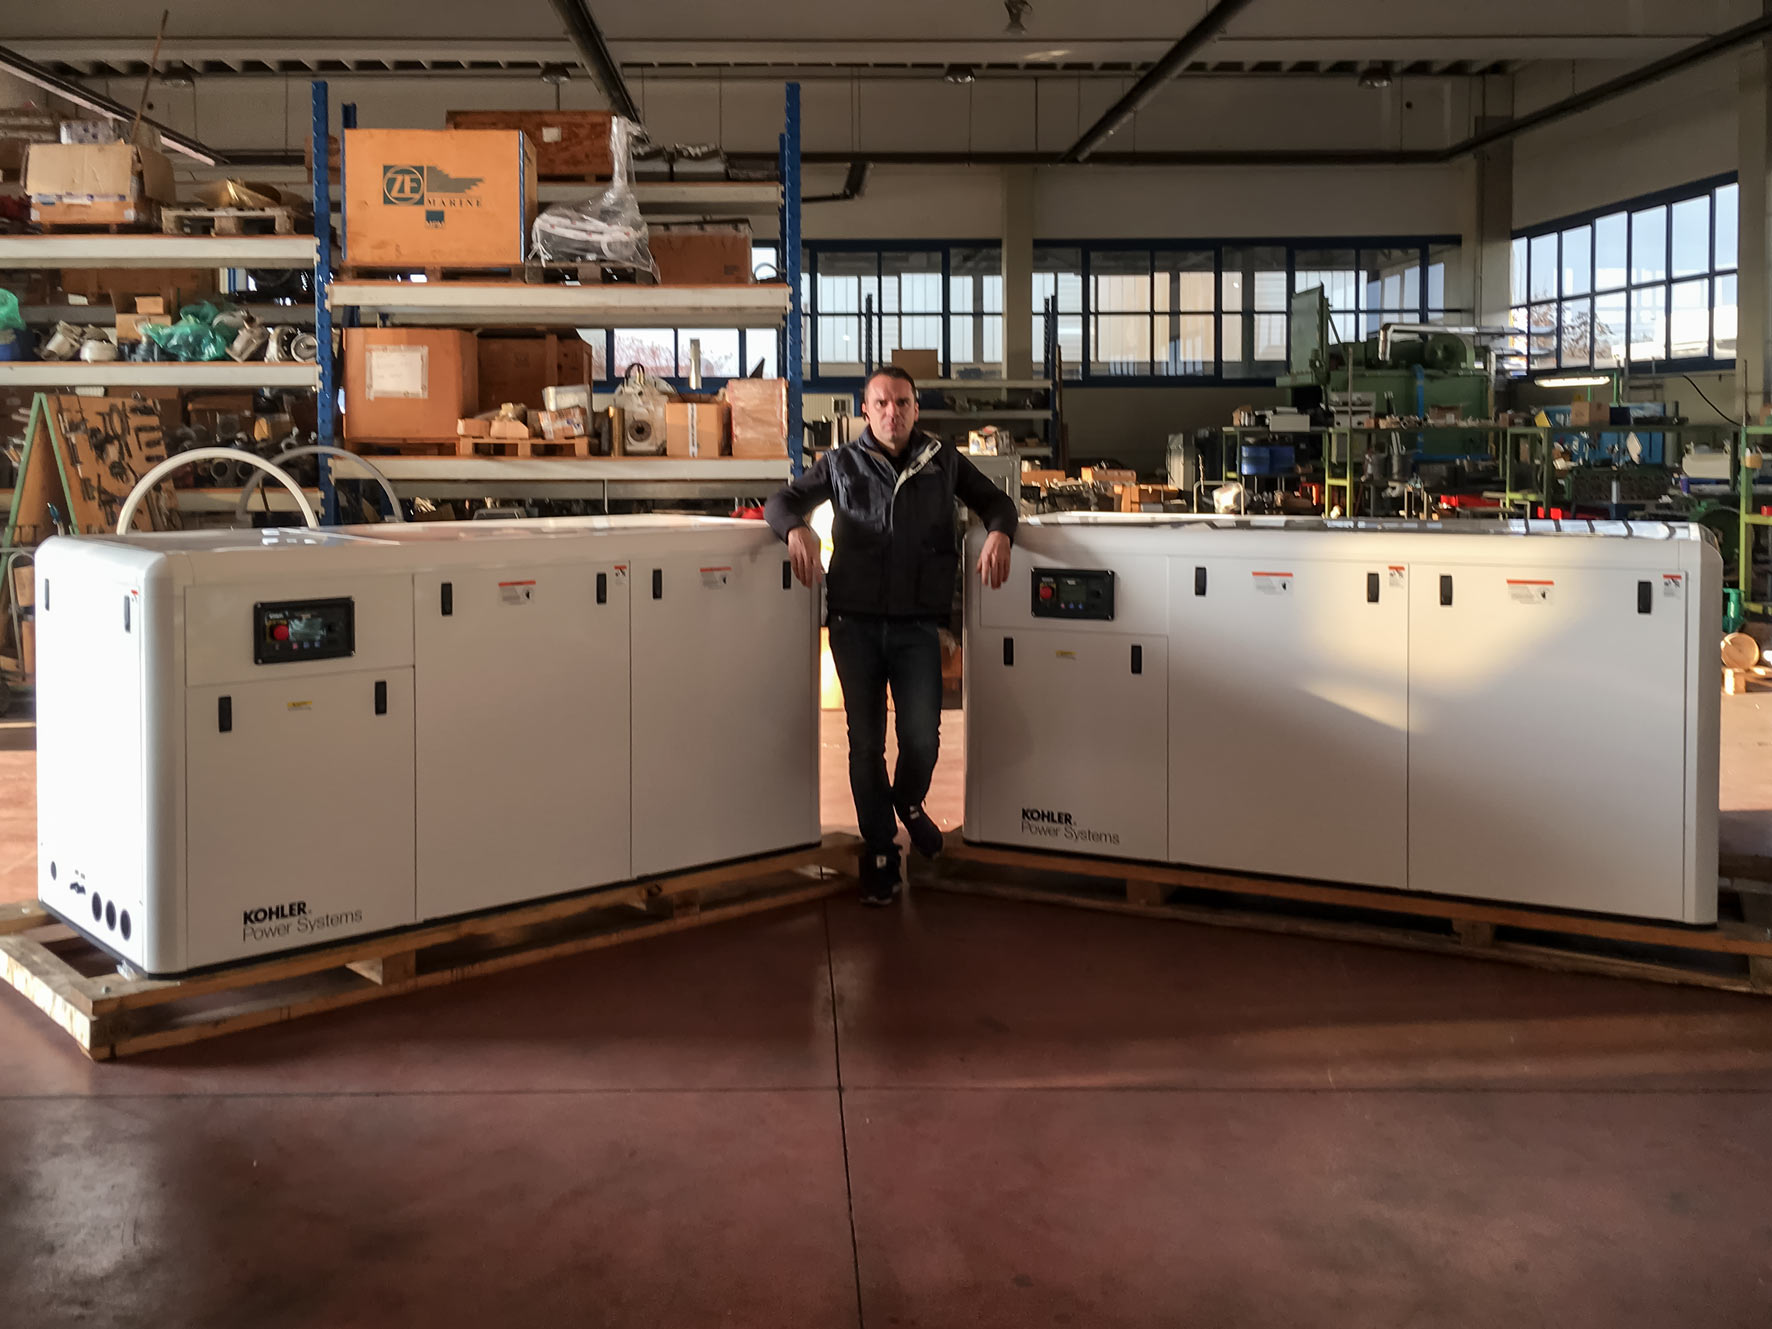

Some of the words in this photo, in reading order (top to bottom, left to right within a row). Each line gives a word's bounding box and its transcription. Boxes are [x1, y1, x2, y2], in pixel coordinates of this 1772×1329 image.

[426, 198, 482, 208] MARINE
[1021, 807, 1074, 826] KOHLER
[1021, 820, 1060, 838] Power
[1063, 825, 1120, 845] Systems
[242, 900, 307, 926] KOHLER
[242, 923, 292, 942] Power
[296, 909, 363, 934] Systems
